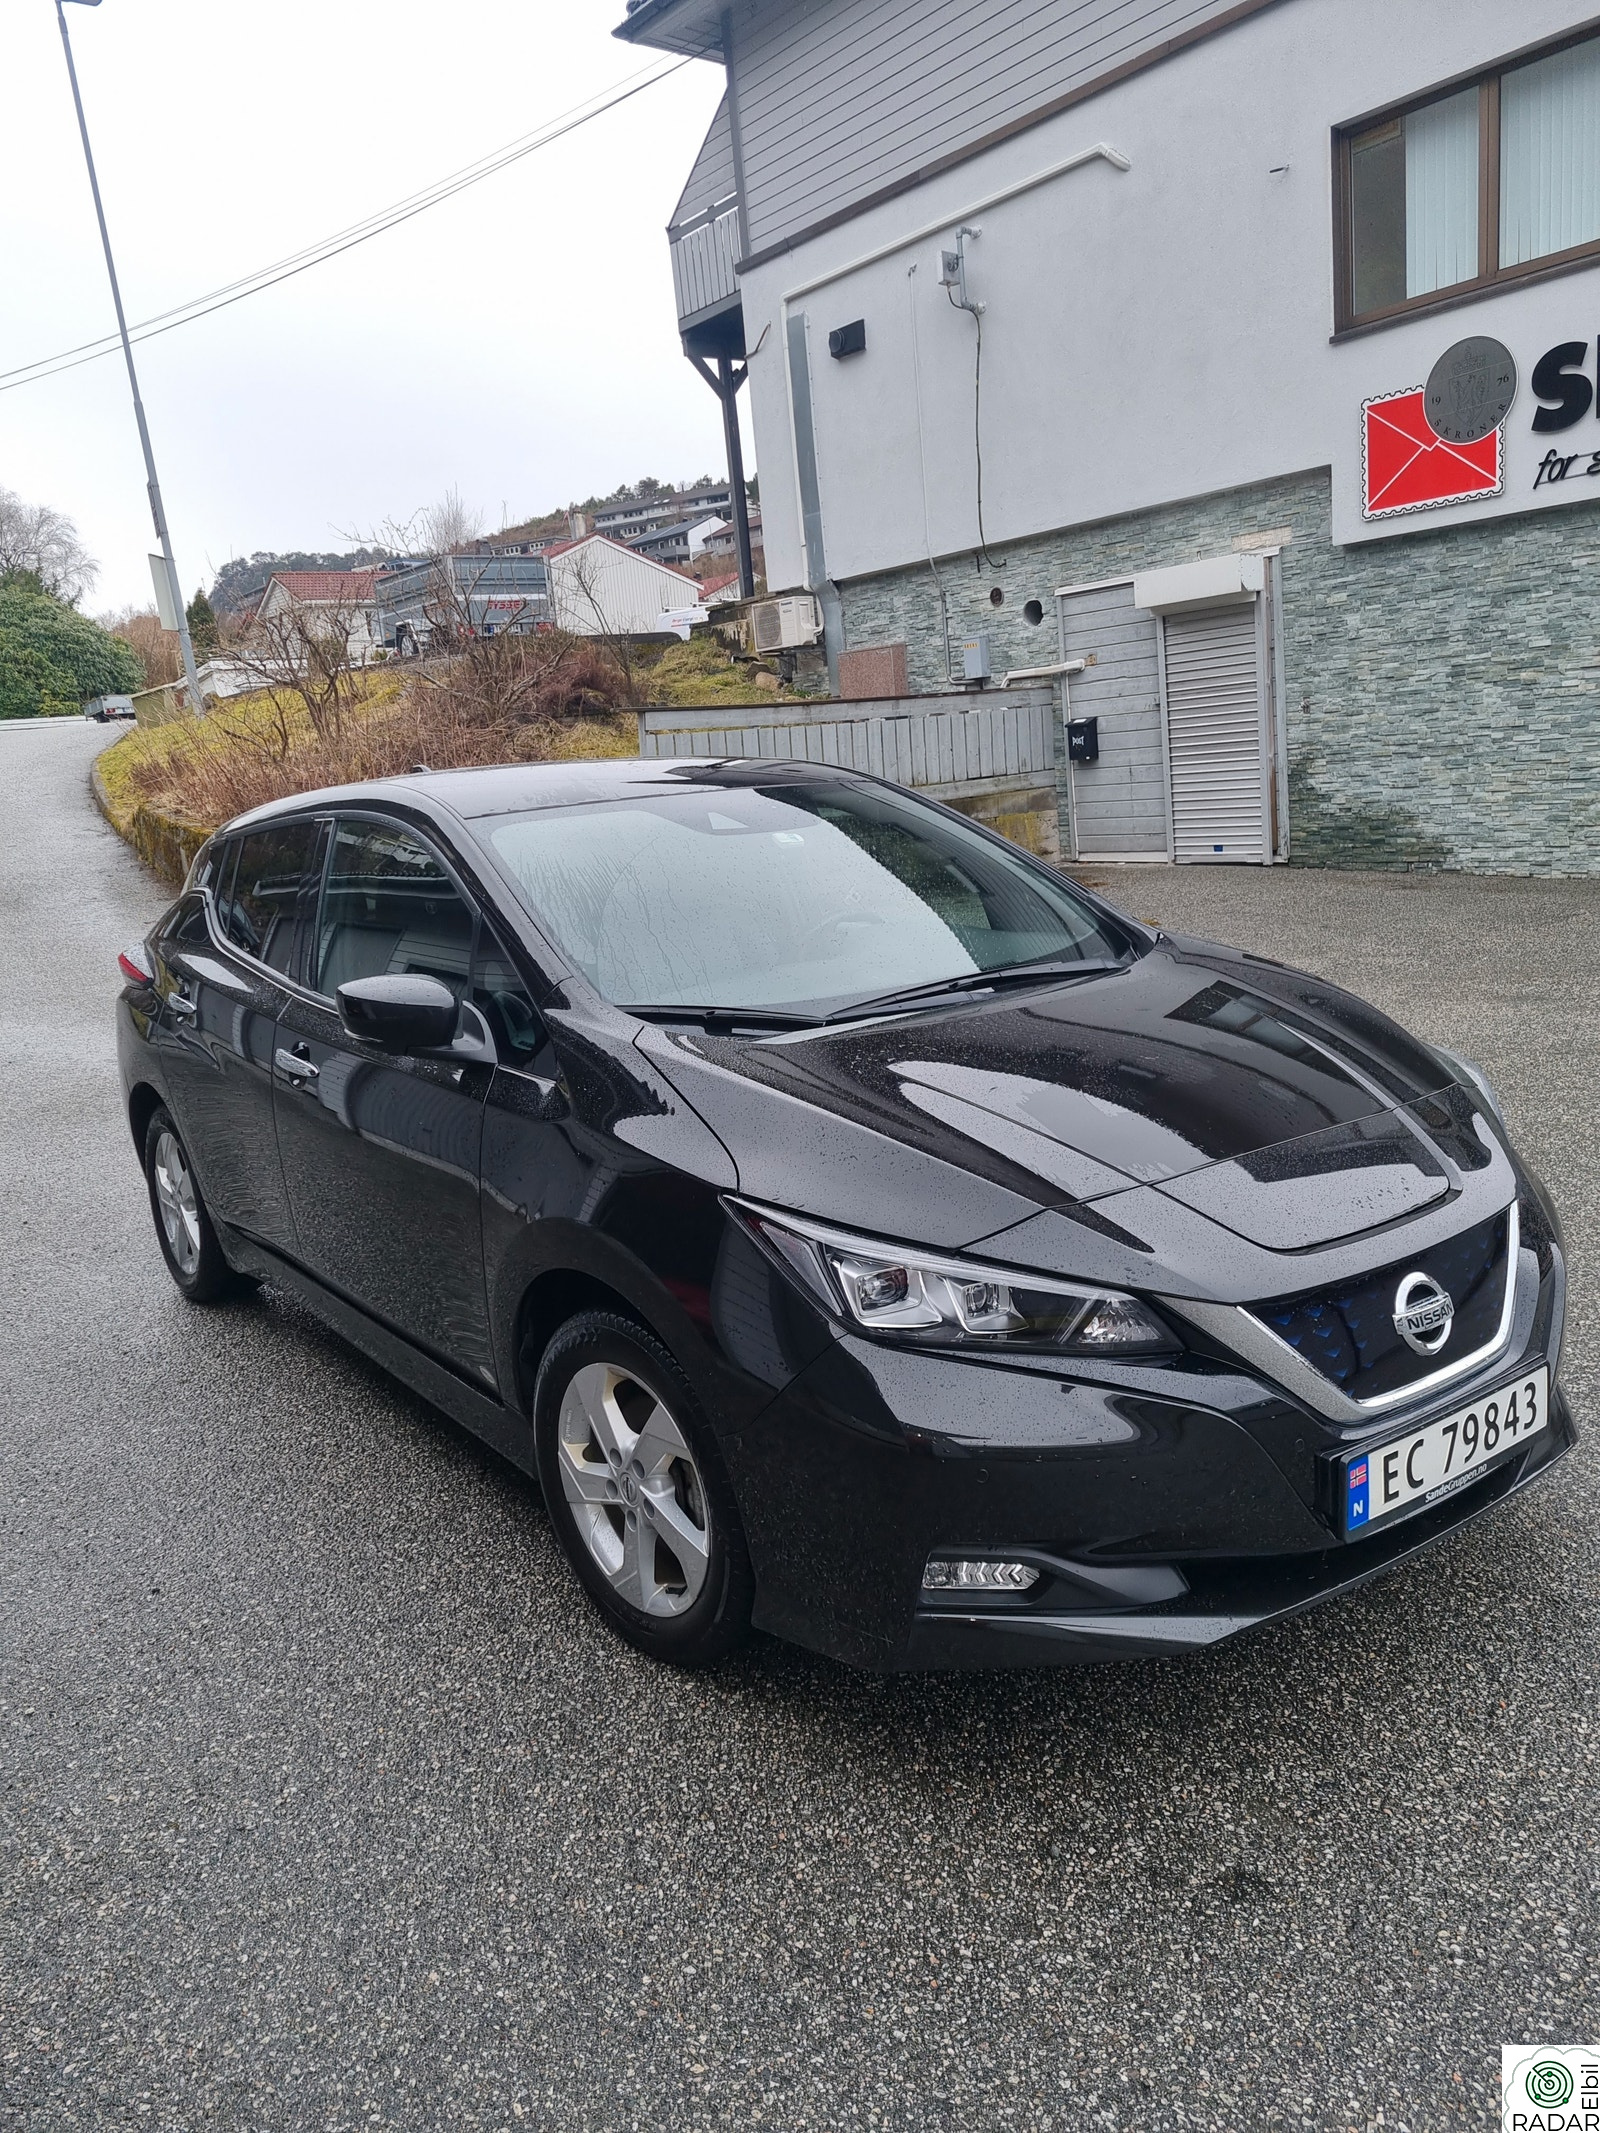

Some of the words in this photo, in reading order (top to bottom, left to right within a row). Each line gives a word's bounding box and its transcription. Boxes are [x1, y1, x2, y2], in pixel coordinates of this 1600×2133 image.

[1431, 396, 1442, 406] 19
[1497, 373, 1510, 385] 76
[1434, 403, 1507, 439] SKRONER
[1532, 449, 1578, 490] for
[1407, 1303, 1453, 1330] NISSAN
[1383, 1438, 1425, 1504] EC
[1441, 1381, 1538, 1475] 79843
[1425, 1463, 1488, 1503] SandeGruppen.no
[1353, 1499, 1364, 1517] N
